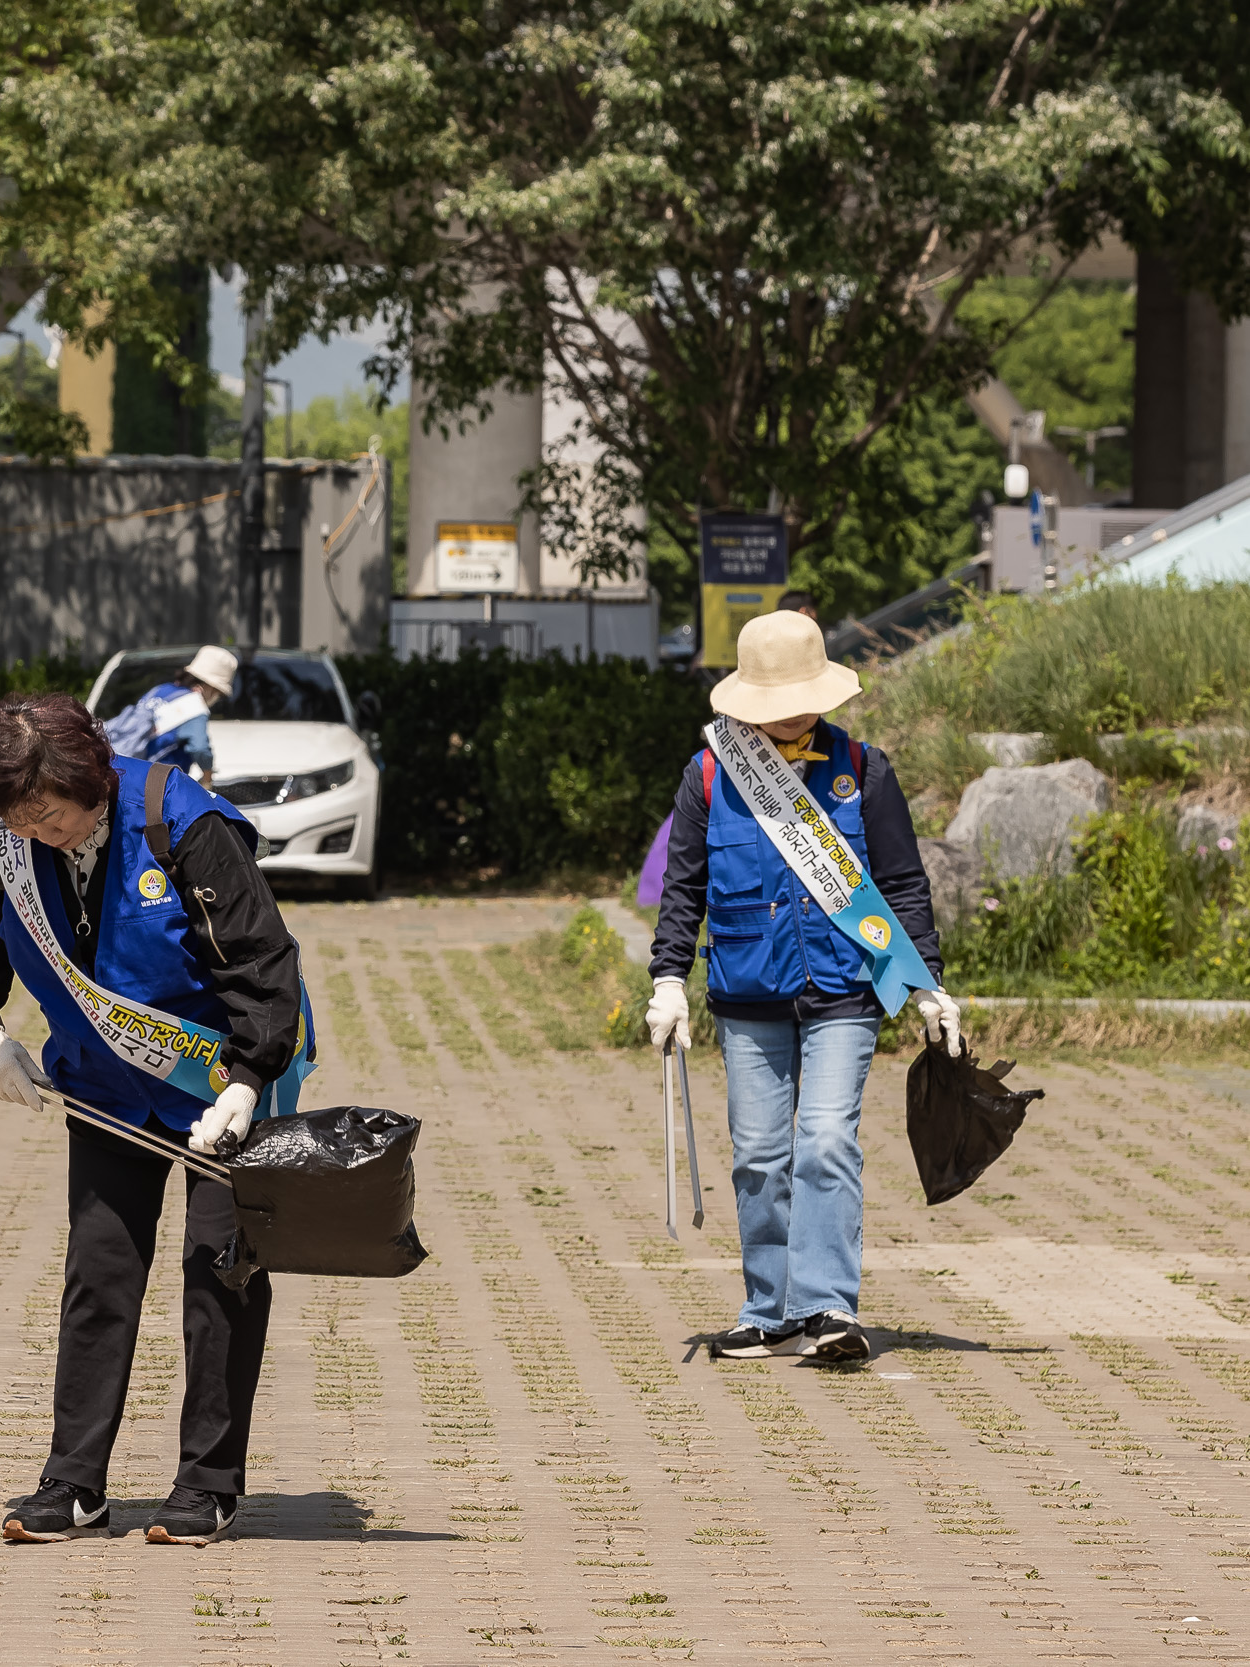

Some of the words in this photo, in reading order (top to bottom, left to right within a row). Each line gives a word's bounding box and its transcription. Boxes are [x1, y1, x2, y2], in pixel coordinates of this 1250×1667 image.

[713, 717, 783, 819] 바르게살기운동
[778, 820, 853, 914] 광진구협의회
[20, 878, 55, 952] 발생된
[106, 1003, 221, 1067] 되가져오고
[63, 976, 174, 1070] 조심합시다
